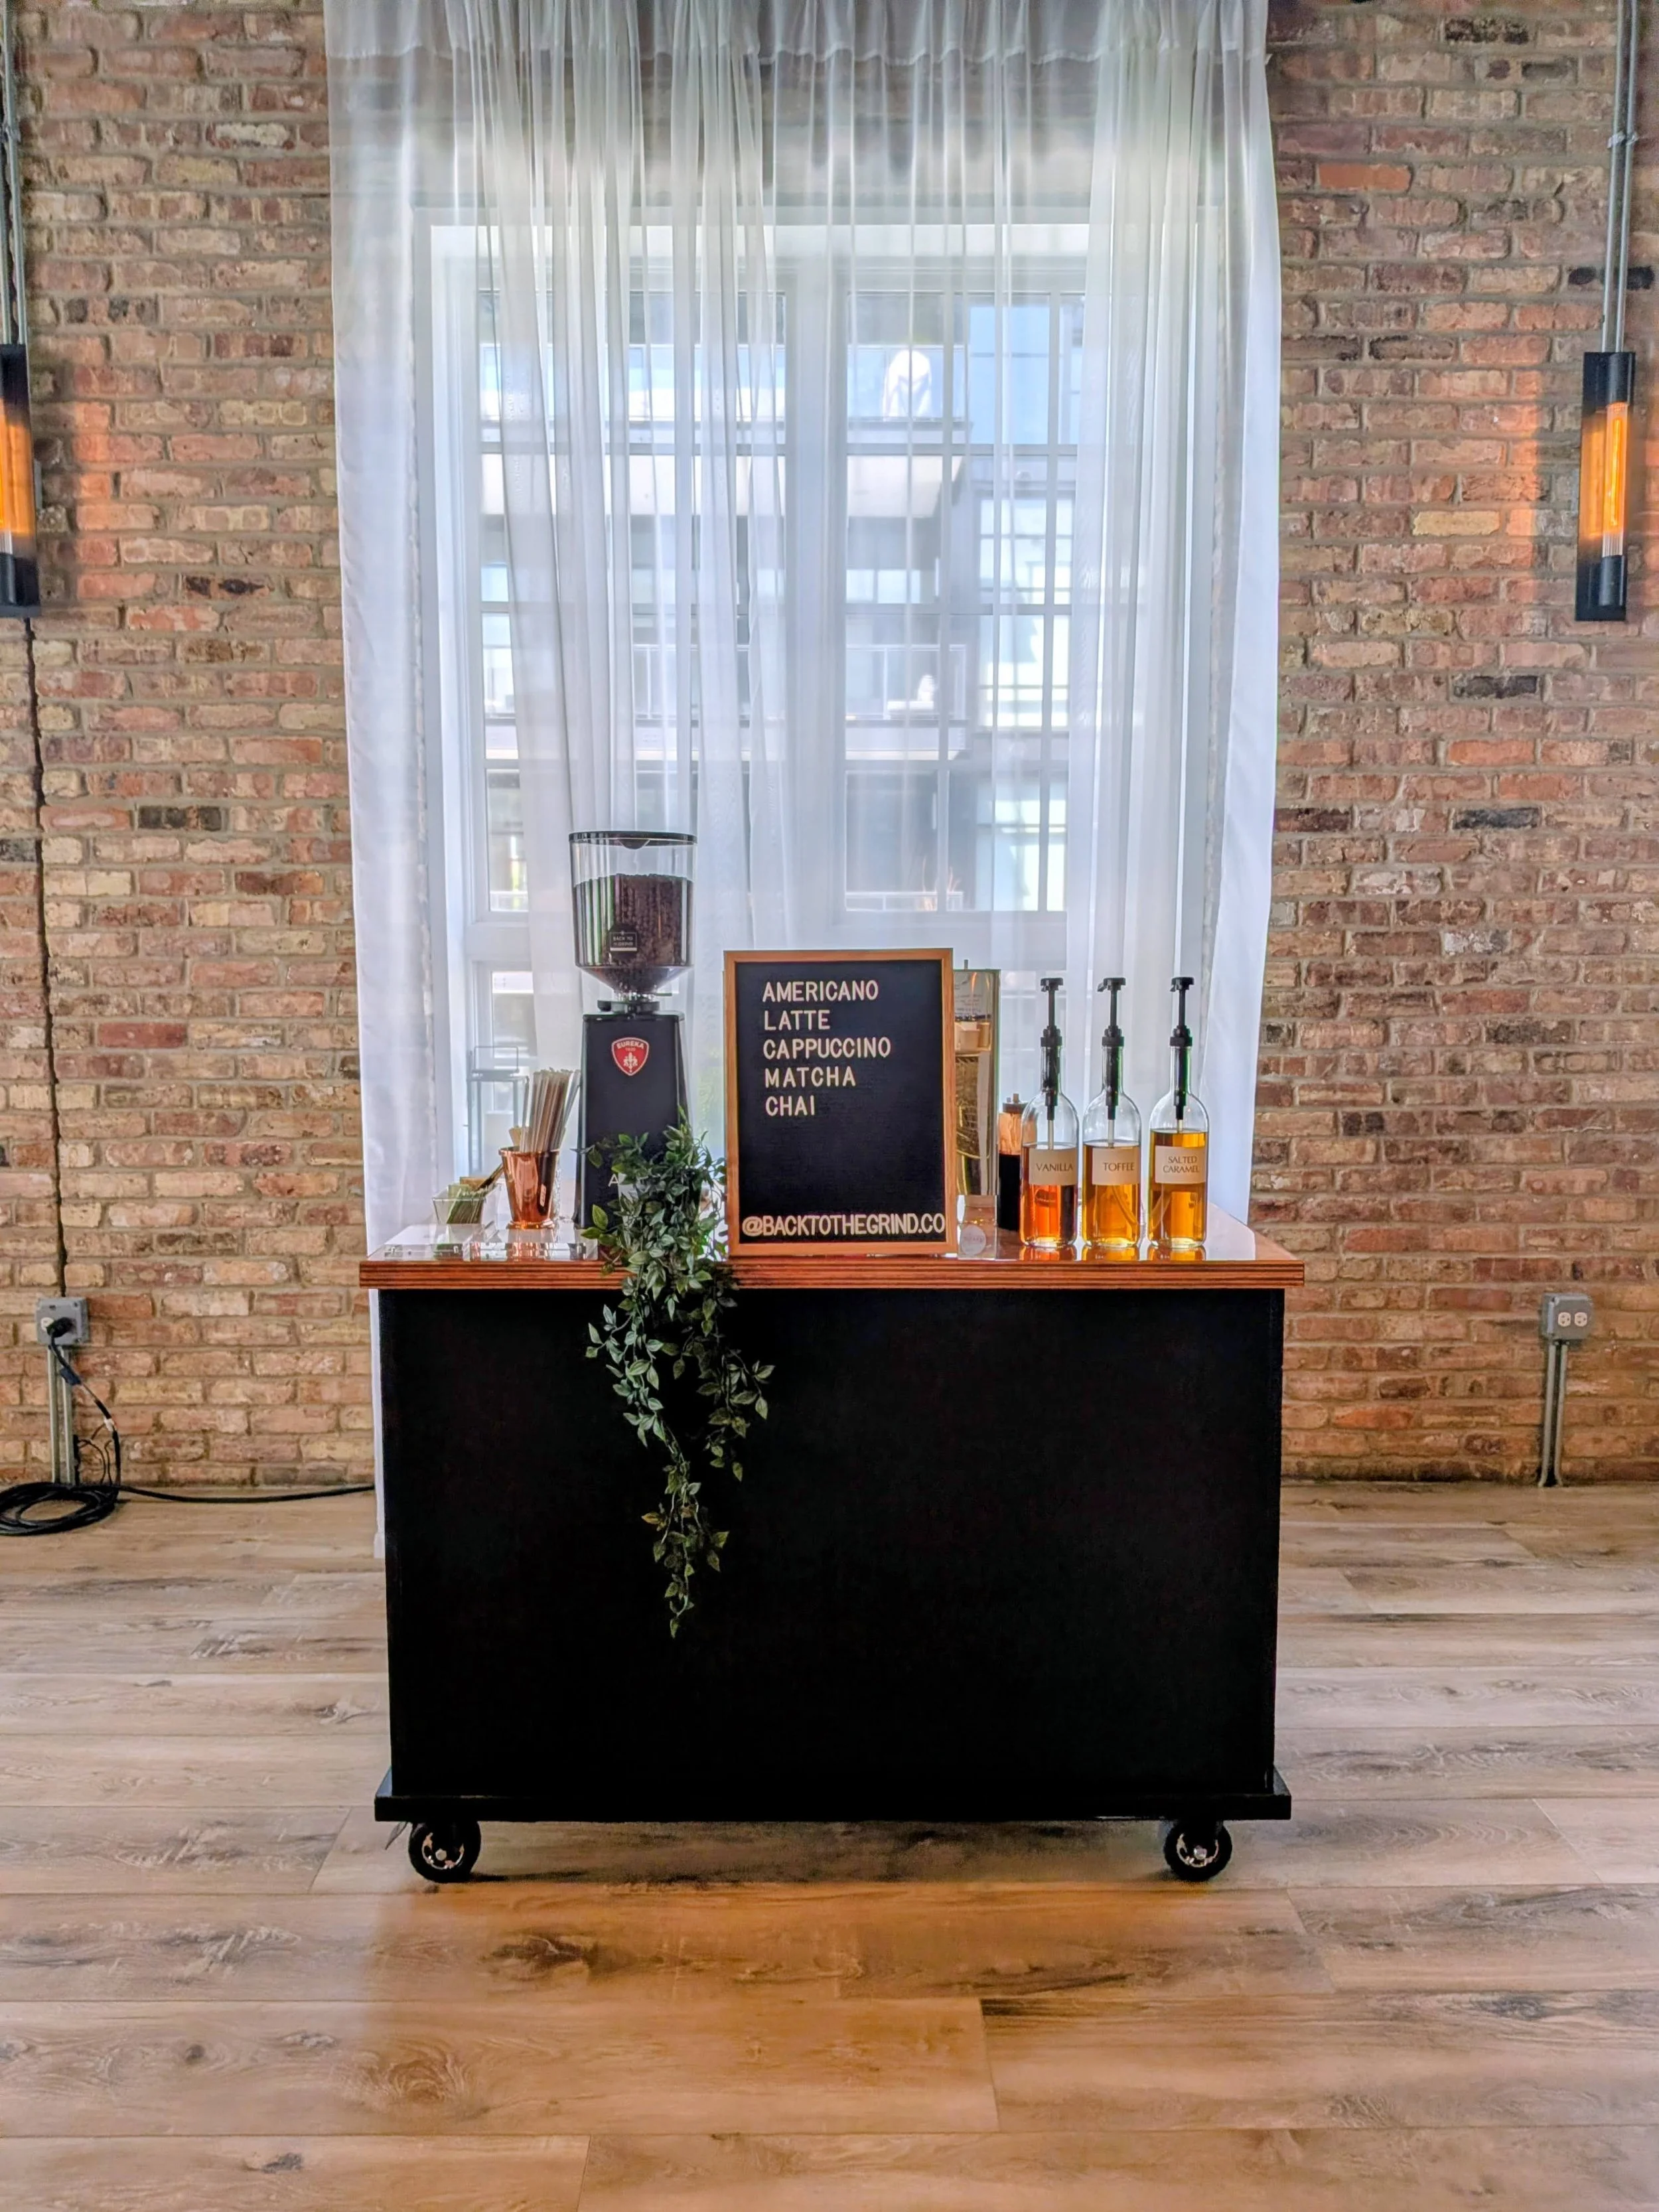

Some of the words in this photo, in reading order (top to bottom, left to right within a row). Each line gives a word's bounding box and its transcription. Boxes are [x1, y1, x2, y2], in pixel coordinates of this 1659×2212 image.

[762, 980, 879, 1003] AMERICANO
[764, 1009, 830, 1031] LATTE
[763, 1037, 891, 1059] CAPPUCCINO
[765, 1066, 855, 1088] MATCHA
[765, 1095, 815, 1116] CHAI
[1036, 1163, 1073, 1171] VANILLA
[1103, 1162, 1135, 1171] TOFFEE
[742, 1213, 945, 1236] @BACKTOTHEGRIND.CO
